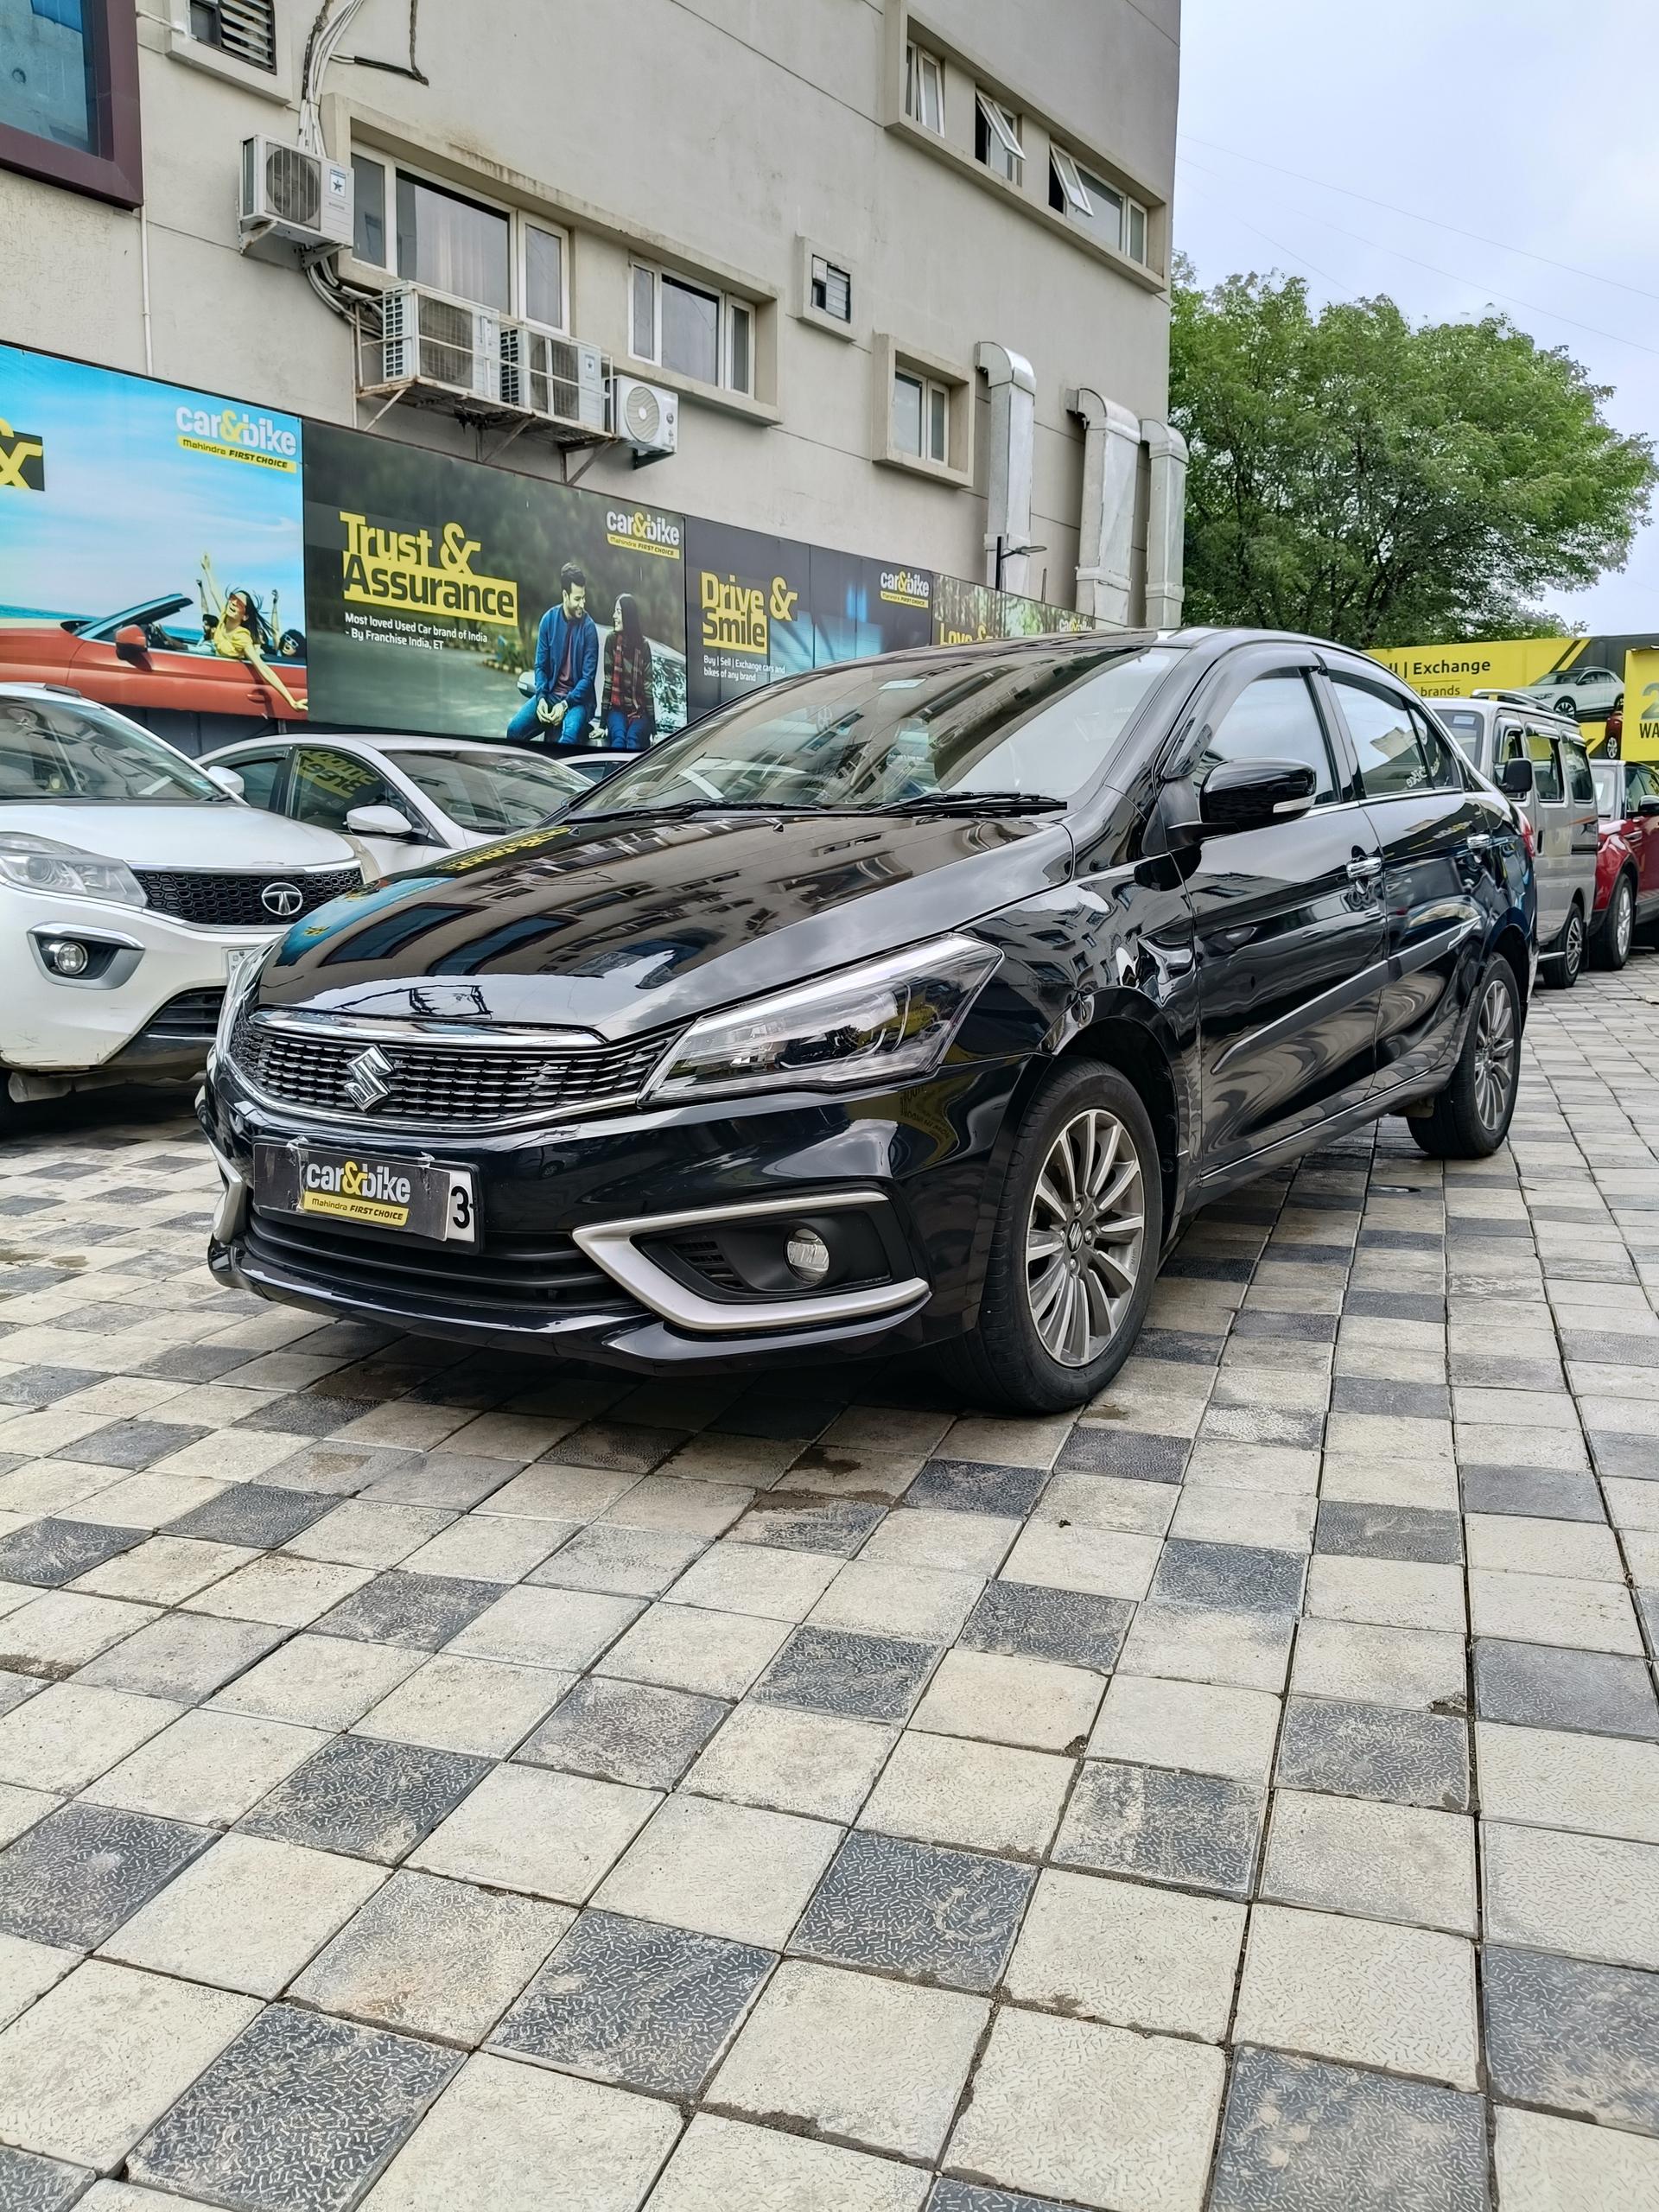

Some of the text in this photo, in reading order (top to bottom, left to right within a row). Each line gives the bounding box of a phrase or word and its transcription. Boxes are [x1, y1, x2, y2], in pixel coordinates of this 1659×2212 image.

[175, 406, 296, 456] car&bike
[182, 439, 288, 468] Mahindra FIRST CHOICE
[340, 511, 481, 575] Trust &
[607, 511, 680, 546] car&bike
[638, 543, 654, 551] FIRST
[342, 553, 514, 619] Assurance
[701, 571, 798, 621] Drive &
[880, 570, 930, 598] car&bike
[345, 612, 488, 643] Most loved Used Car brand of India
[351, 628, 364, 641] By
[365, 631, 407, 645] Franchise
[433, 640, 444, 651] ET
[702, 606, 766, 647] Smile
[703, 655, 716, 667] Buy
[720, 657, 732, 667] Sell
[735, 659, 762, 672] Exchange
[762, 664, 774, 673] cars
[775, 664, 785, 674] and
[703, 666, 756, 682] bikes of any brand
[1413, 659, 1491, 675] Exchange
[1421, 684, 1460, 696] brands
[306, 1160, 411, 1204] car&bike
[311, 1198, 404, 1220] Mahindra FIRST CHOICE
[450, 1185, 471, 1229] 3
